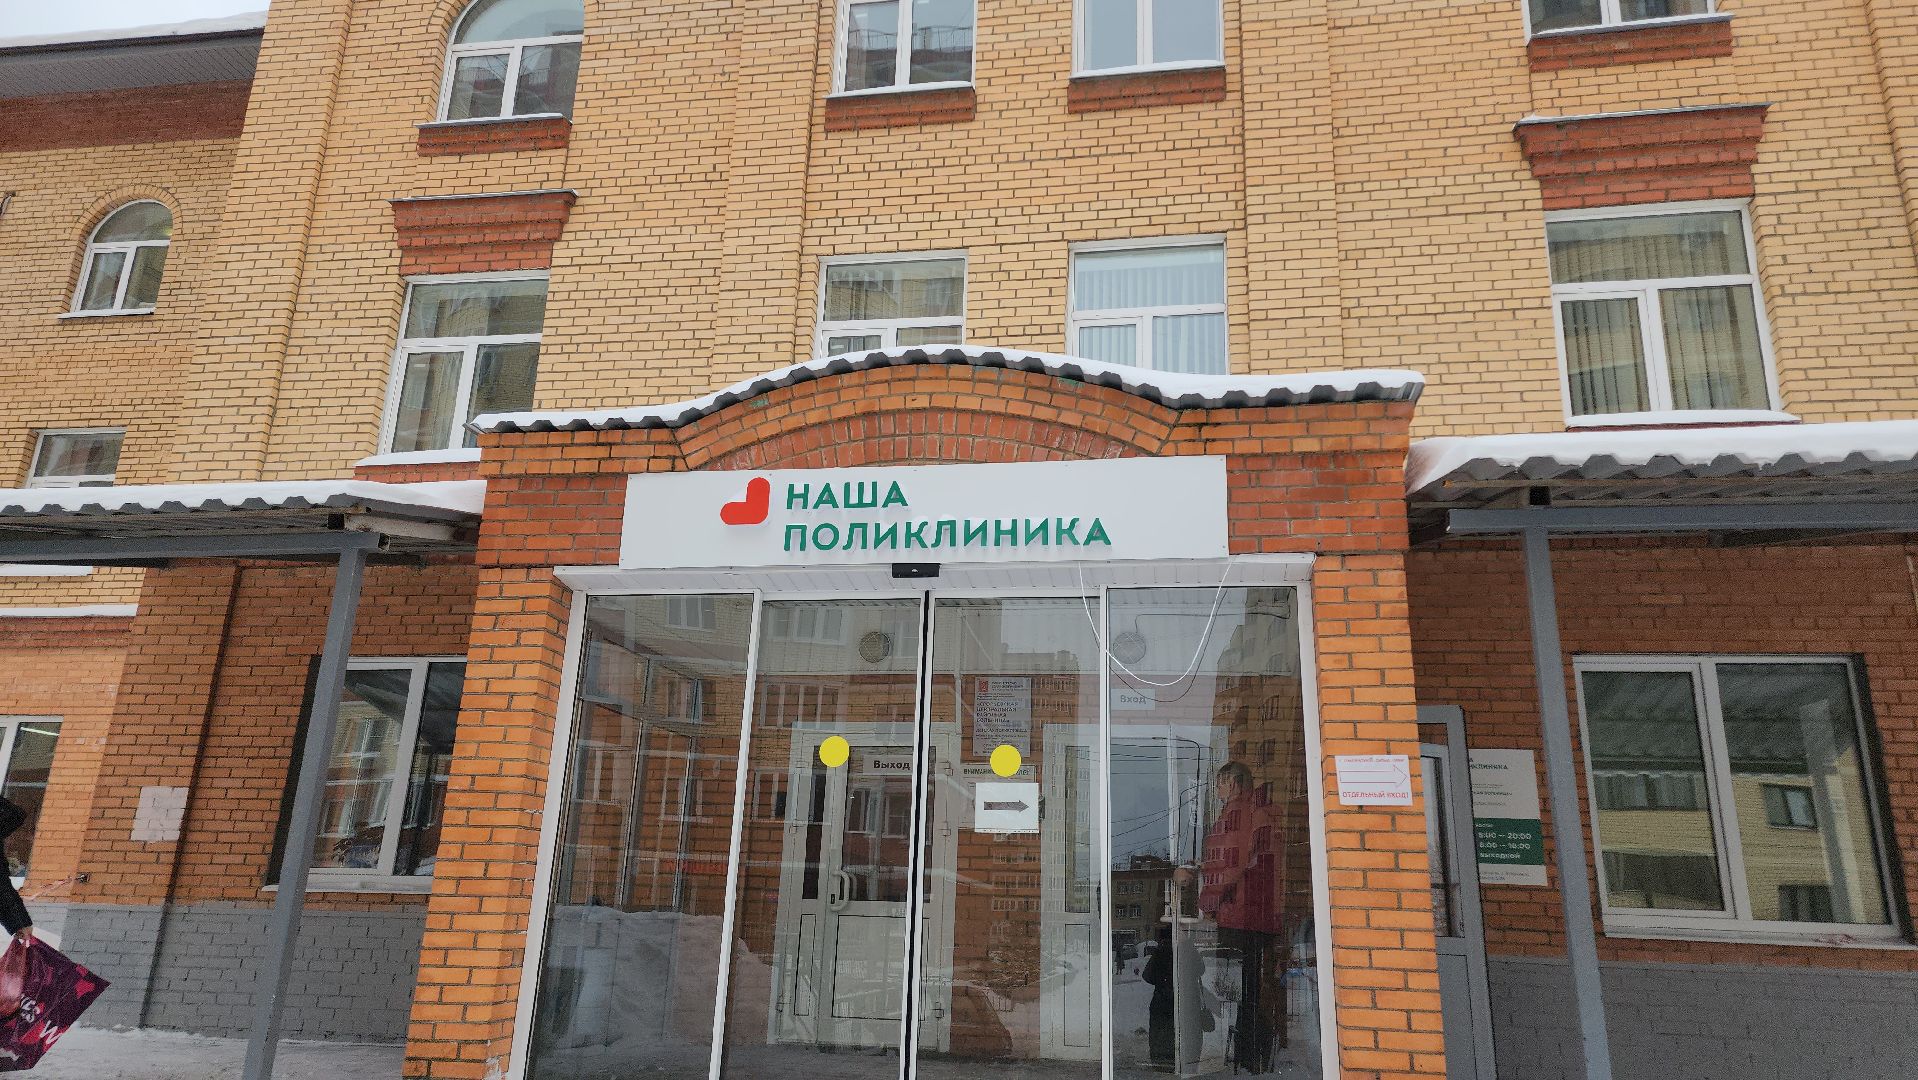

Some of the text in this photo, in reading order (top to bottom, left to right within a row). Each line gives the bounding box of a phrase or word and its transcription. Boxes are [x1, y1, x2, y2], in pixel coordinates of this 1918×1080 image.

[785, 480, 909, 510] НАША
[784, 517, 1112, 552] ПОЛИКЛИНИКА
[1120, 694, 1147, 705] Вход
[873, 760, 911, 771] Выход
[1342, 790, 1386, 798] ОТДЕЛЬНЫЙ
[1507, 832, 1532, 840] 20:00
